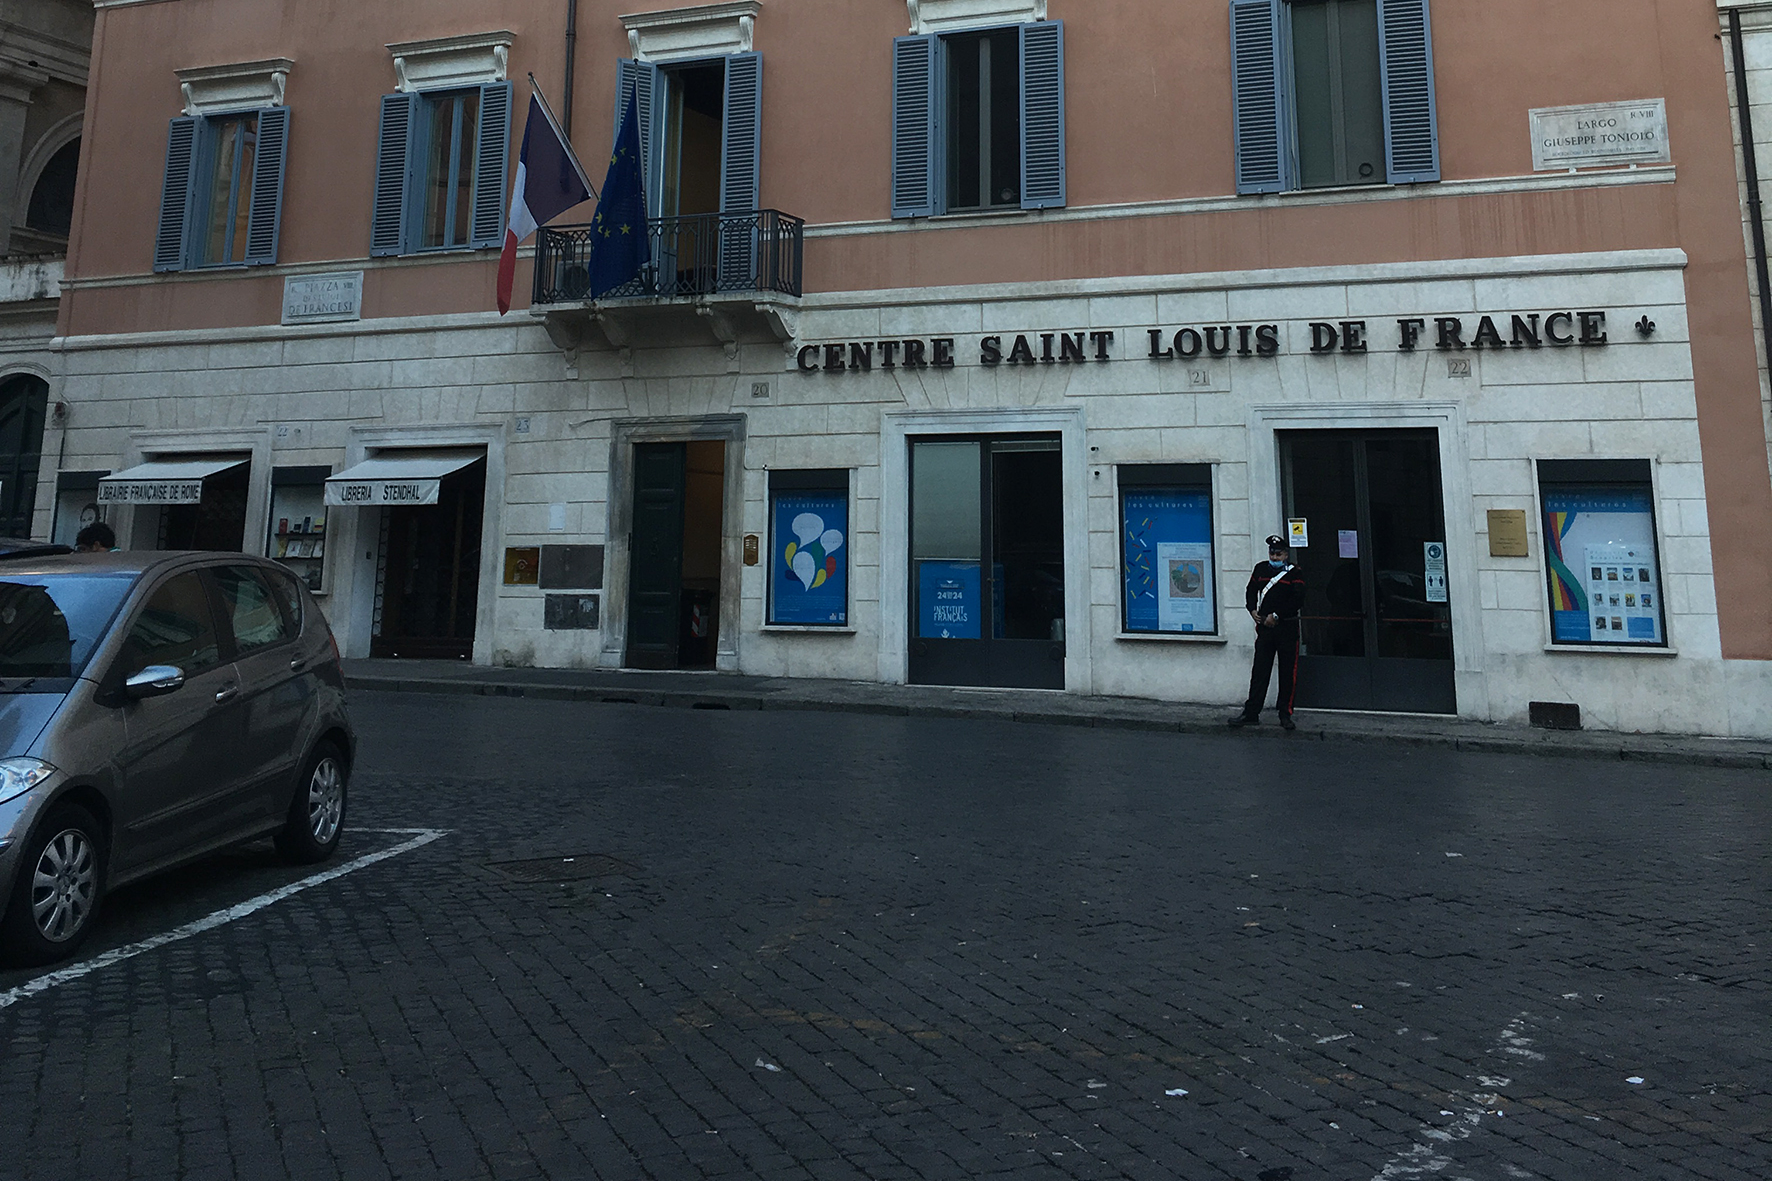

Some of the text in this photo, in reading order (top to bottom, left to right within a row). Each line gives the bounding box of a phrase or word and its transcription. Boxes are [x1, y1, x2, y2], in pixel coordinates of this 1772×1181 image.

[1577, 118, 1617, 130] LARGO
[1543, 131, 1655, 148] GIUSEPPE TONIOLO
[305, 281, 339, 293] PIAZZA
[303, 301, 353, 314] FRANCESI
[797, 311, 1608, 370] CENTRE SAINT LOUIS DE FRANCE
[1450, 361, 1468, 375] 22
[1191, 370, 1207, 384] 21
[753, 384, 768, 396] 20
[99, 484, 200, 502] LIBRAIRIE FRANÇAISE DE ROME
[341, 484, 420, 501] LIBRERIA STENDHAL
[933, 605, 965, 615] INSTITUT
[933, 612, 968, 623] FRANÇAIS
